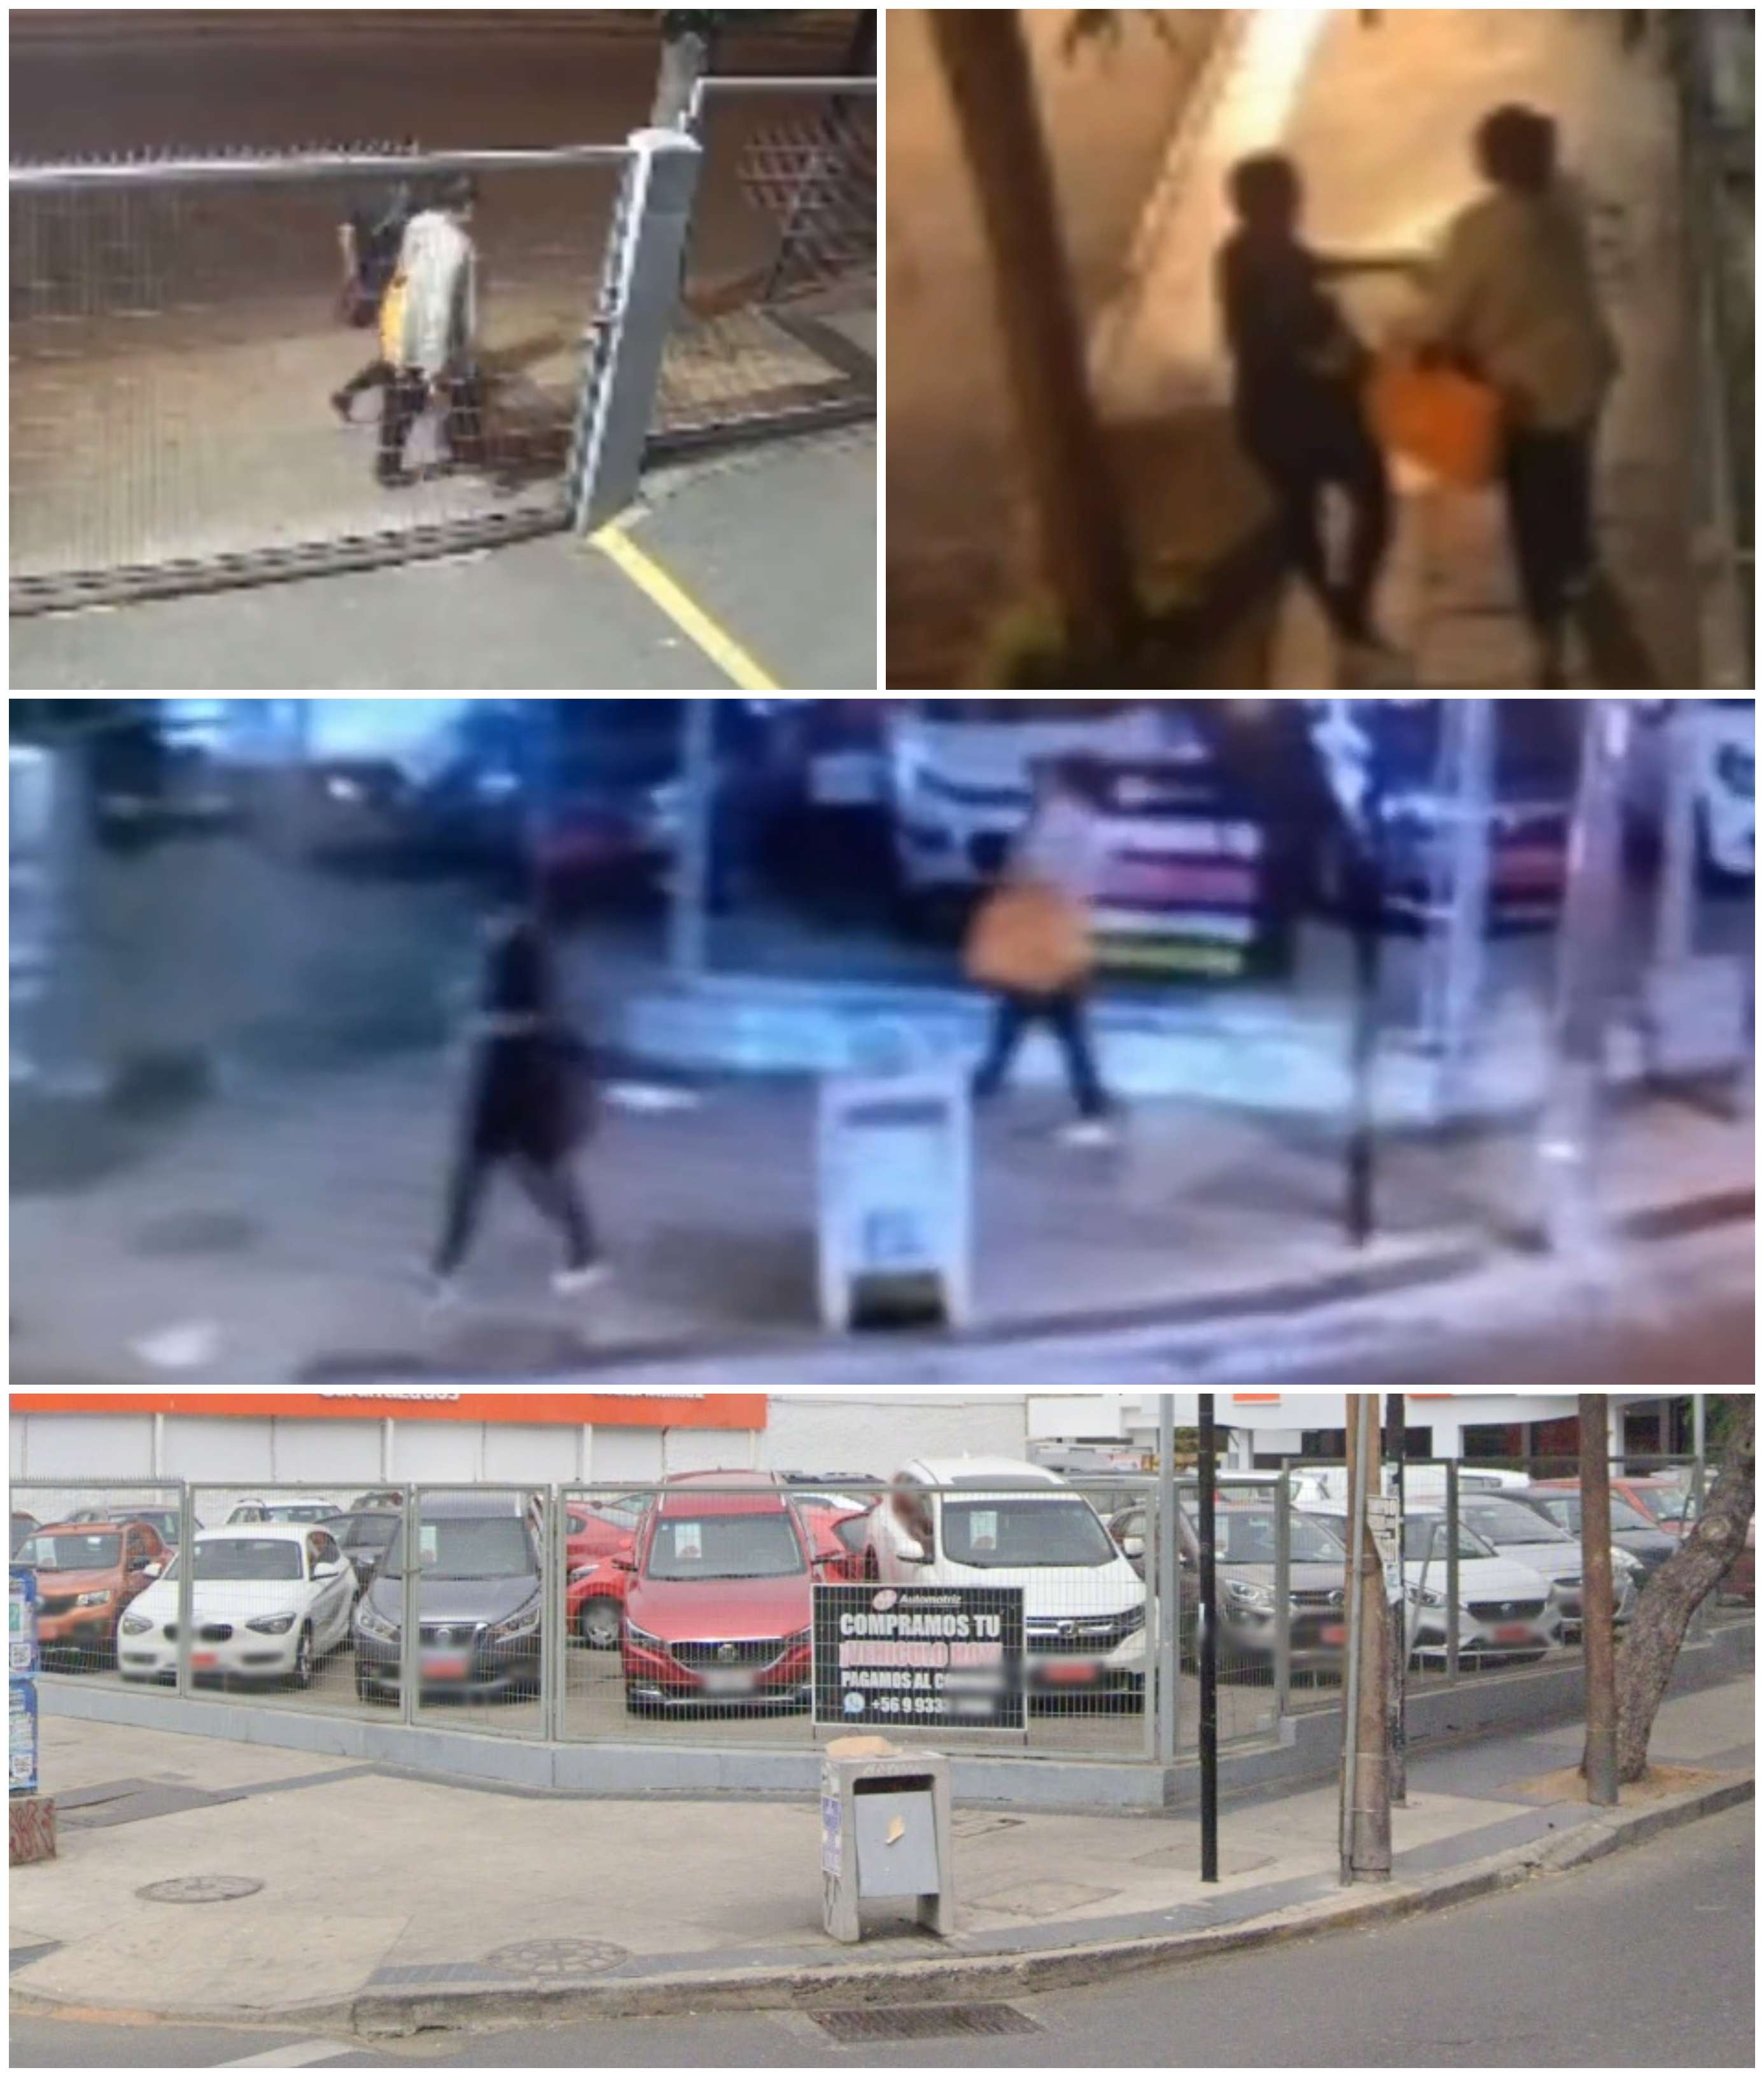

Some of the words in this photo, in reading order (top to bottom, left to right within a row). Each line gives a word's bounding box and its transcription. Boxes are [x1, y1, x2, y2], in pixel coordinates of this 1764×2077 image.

[899, 1594, 962, 1604] Automotriz
[840, 1612, 970, 1637] COMPRAMOS
[973, 1614, 1000, 1637] TU
[841, 1671, 912, 1689] PAGAMOS
[913, 1672, 932, 1689] AL
[871, 1696, 900, 1713] +56
[902, 1696, 912, 1714] 9
